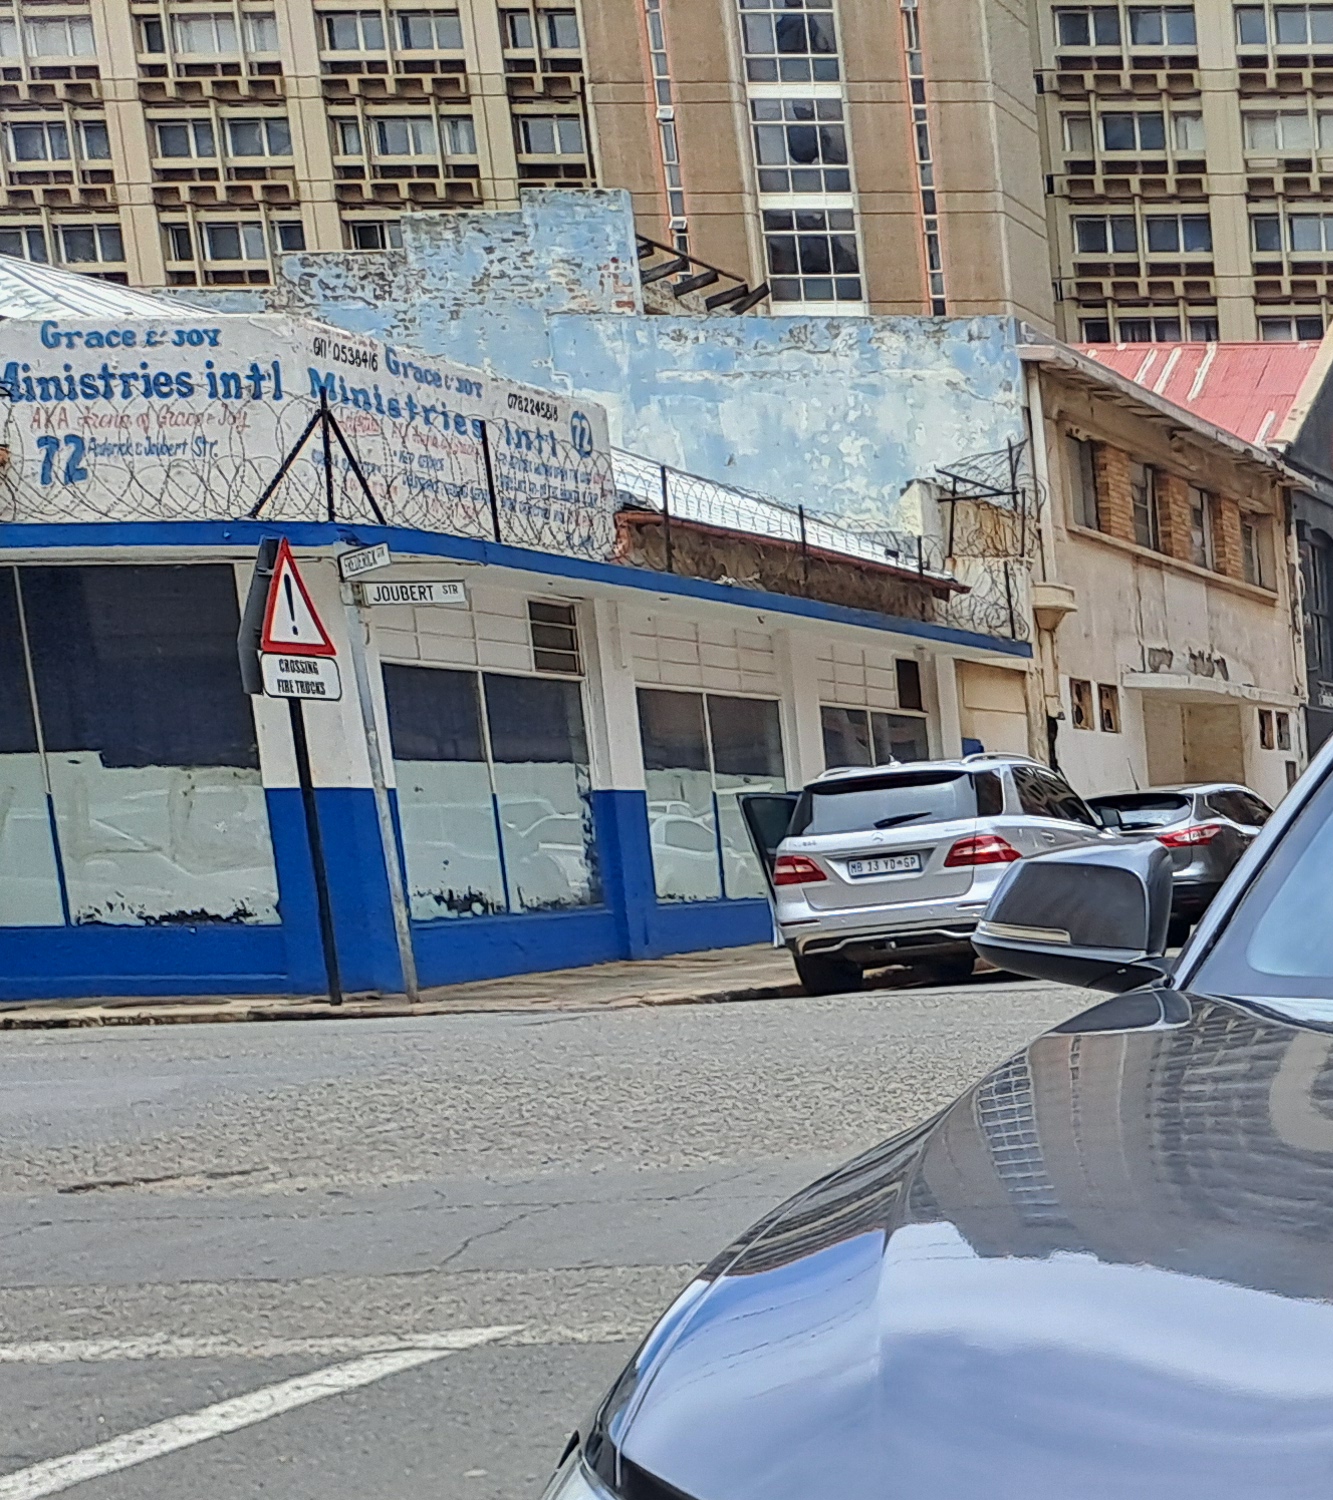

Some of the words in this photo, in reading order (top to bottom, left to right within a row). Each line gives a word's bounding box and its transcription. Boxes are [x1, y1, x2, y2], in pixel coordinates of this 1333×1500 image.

[40, 320, 137, 350] Grace
[385, 346, 442, 388] Grace
[307, 366, 484, 441] Ministries
[37, 434, 88, 486] 72
[373, 585, 434, 602] JOUBERT
[442, 586, 459, 596] STR
[279, 658, 319, 675] CROSSING
[276, 678, 295, 694] FIRE
[296, 679, 326, 696] TRUCKS
[867, 860, 880, 873] 13
